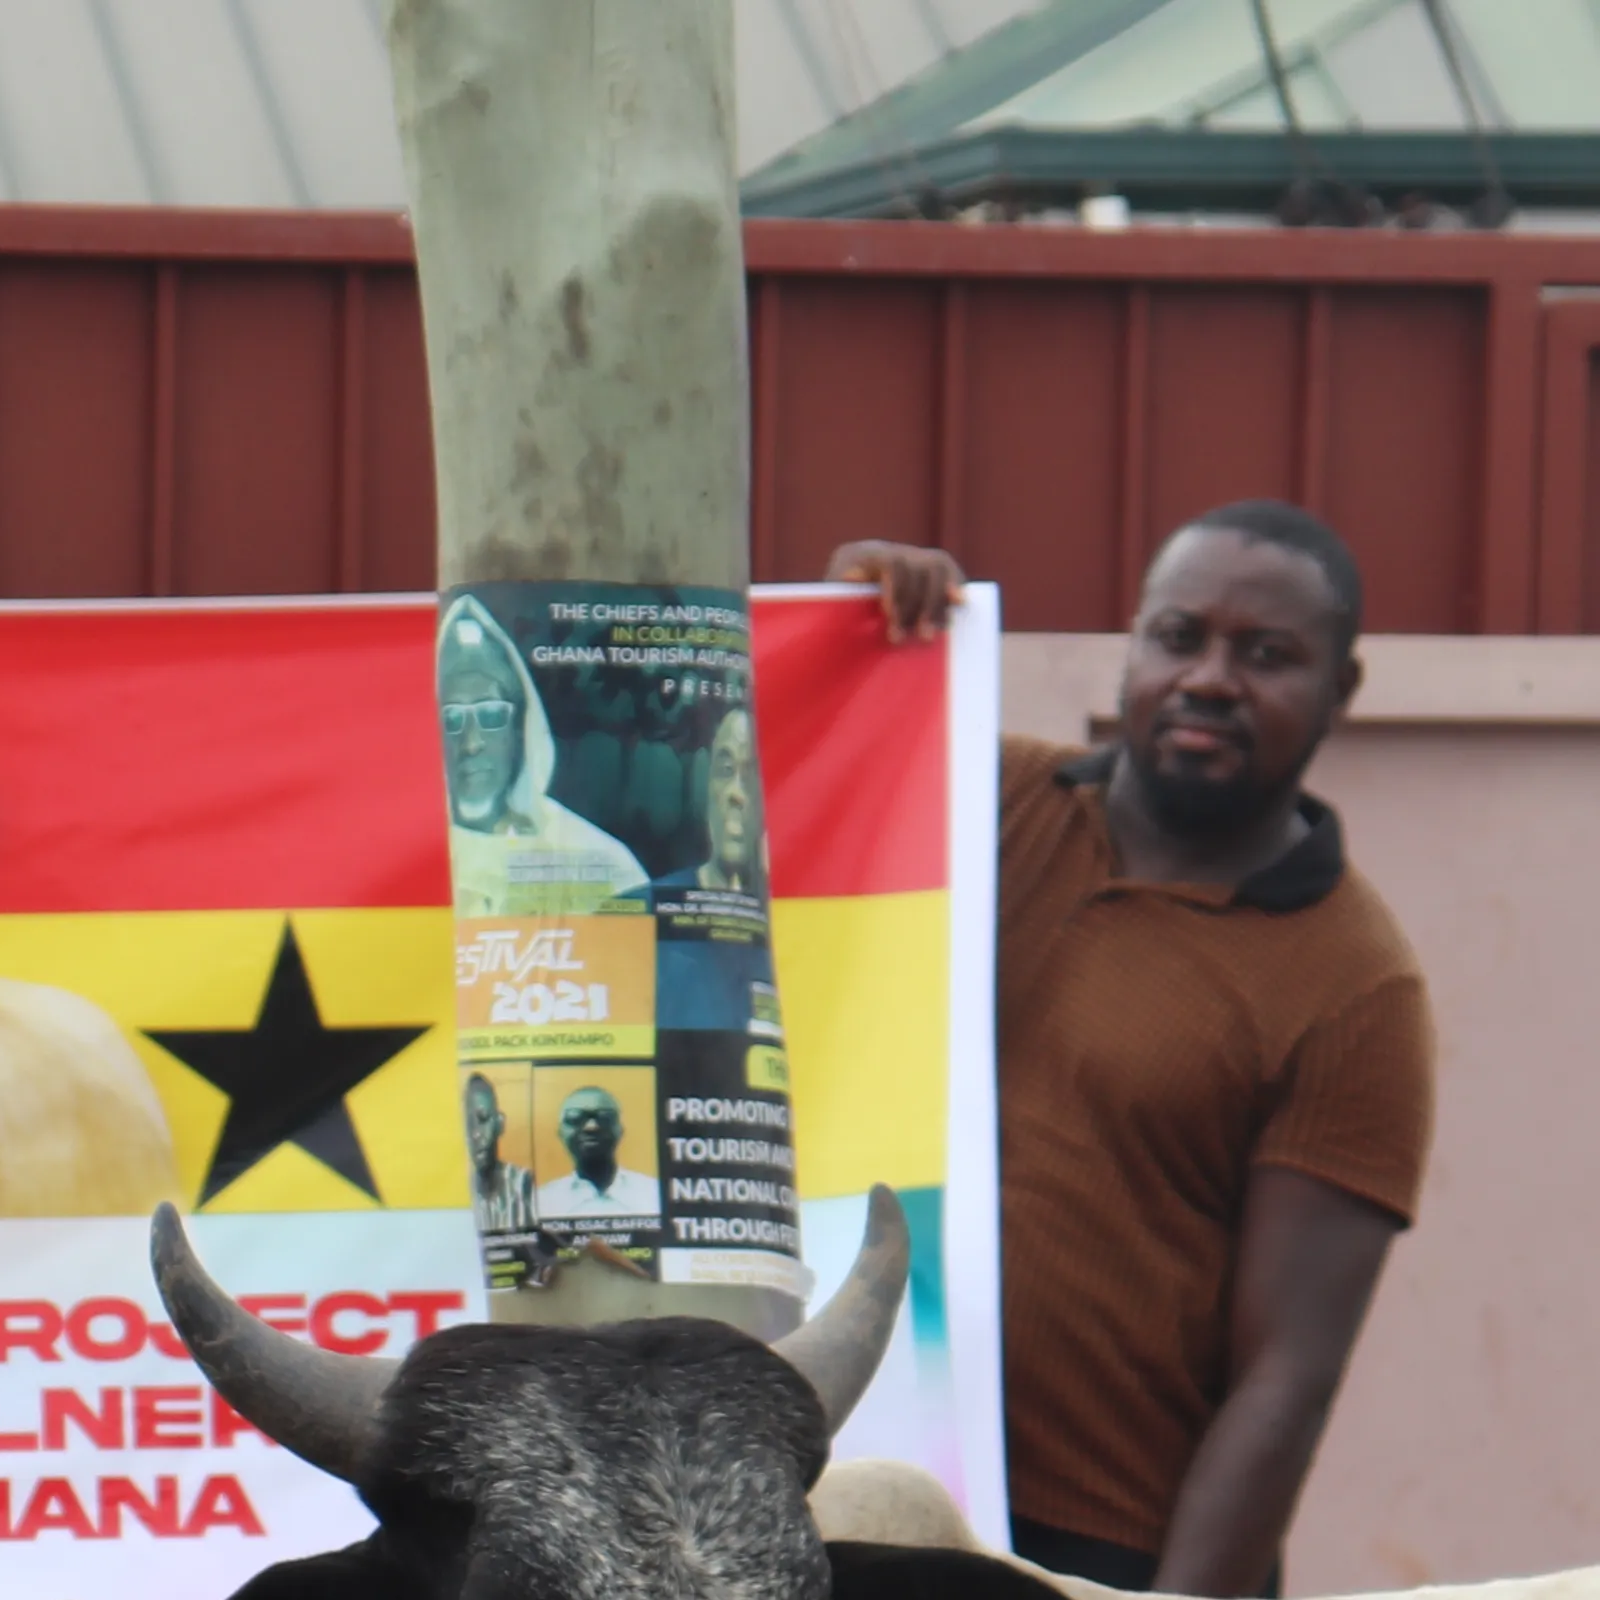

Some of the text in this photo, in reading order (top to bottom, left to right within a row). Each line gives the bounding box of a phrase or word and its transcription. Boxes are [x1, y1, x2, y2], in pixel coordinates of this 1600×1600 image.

[550, 603, 588, 620] THE
[592, 603, 658, 621] CHIEFS
[662, 604, 701, 623] AND
[612, 626, 634, 642] IN
[532, 646, 605, 664] GHANA
[607, 646, 695, 665] TOURISM
[490, 980, 609, 1025] 2021
[667, 1097, 787, 1128] PROMOTING
[667, 1137, 768, 1165] TOURISM
[670, 1177, 778, 1206] NATIONAL
[671, 1216, 777, 1244] THROUGH
